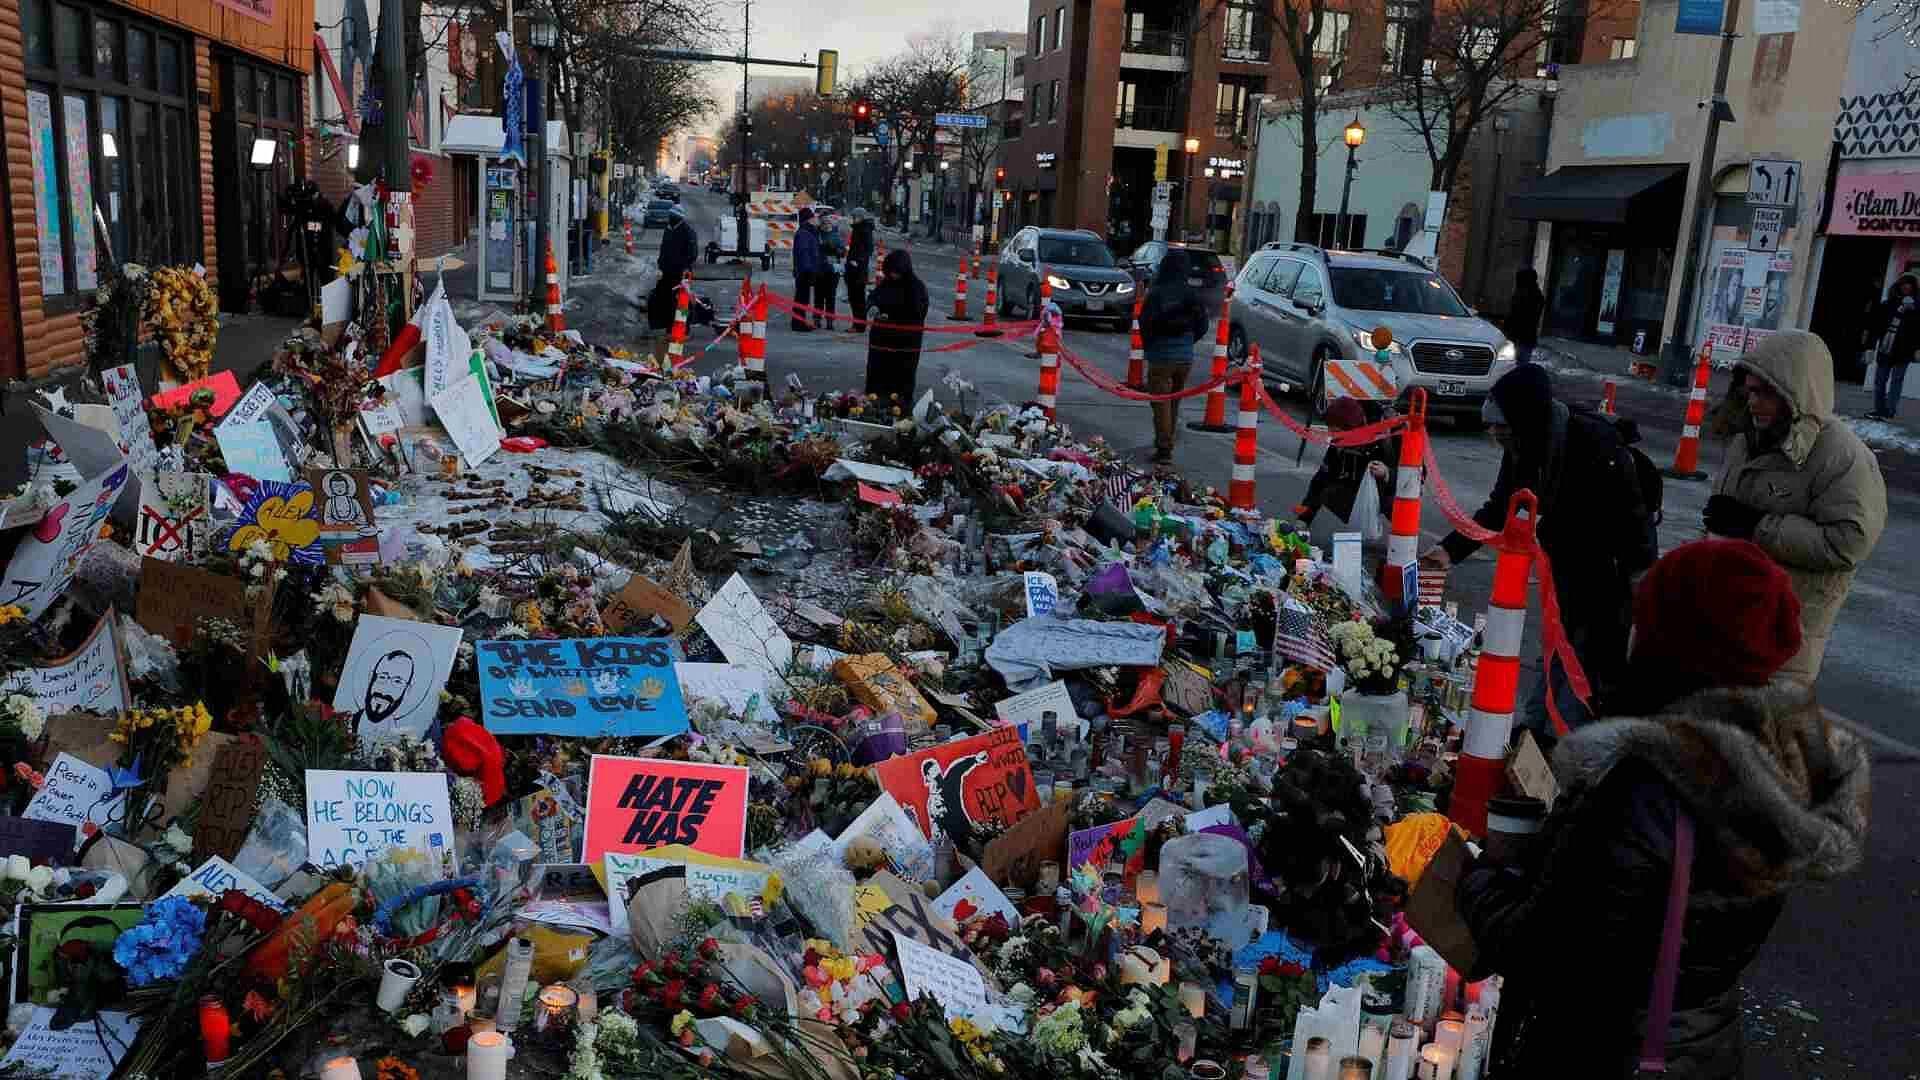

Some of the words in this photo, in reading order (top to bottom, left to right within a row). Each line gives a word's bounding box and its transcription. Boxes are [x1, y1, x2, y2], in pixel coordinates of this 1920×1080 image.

[1757, 211, 1780, 220] TRUCK
[1855, 192, 1898, 217] Glam
[1755, 222, 1778, 232] ROUTE
[1857, 218, 1920, 231] DONUT
[482, 641, 566, 665] THE
[574, 641, 671, 667] KIDS
[489, 698, 577, 718] SEND
[587, 695, 657, 713] LOVE
[346, 779, 395, 799] NOW
[616, 774, 727, 814] HATE
[975, 782, 1008, 818] RIP
[313, 800, 344, 823] HE
[354, 801, 434, 824] BELONGS
[341, 828, 369, 844] TO
[377, 829, 408, 844] THE
[621, 810, 706, 846] HAS
